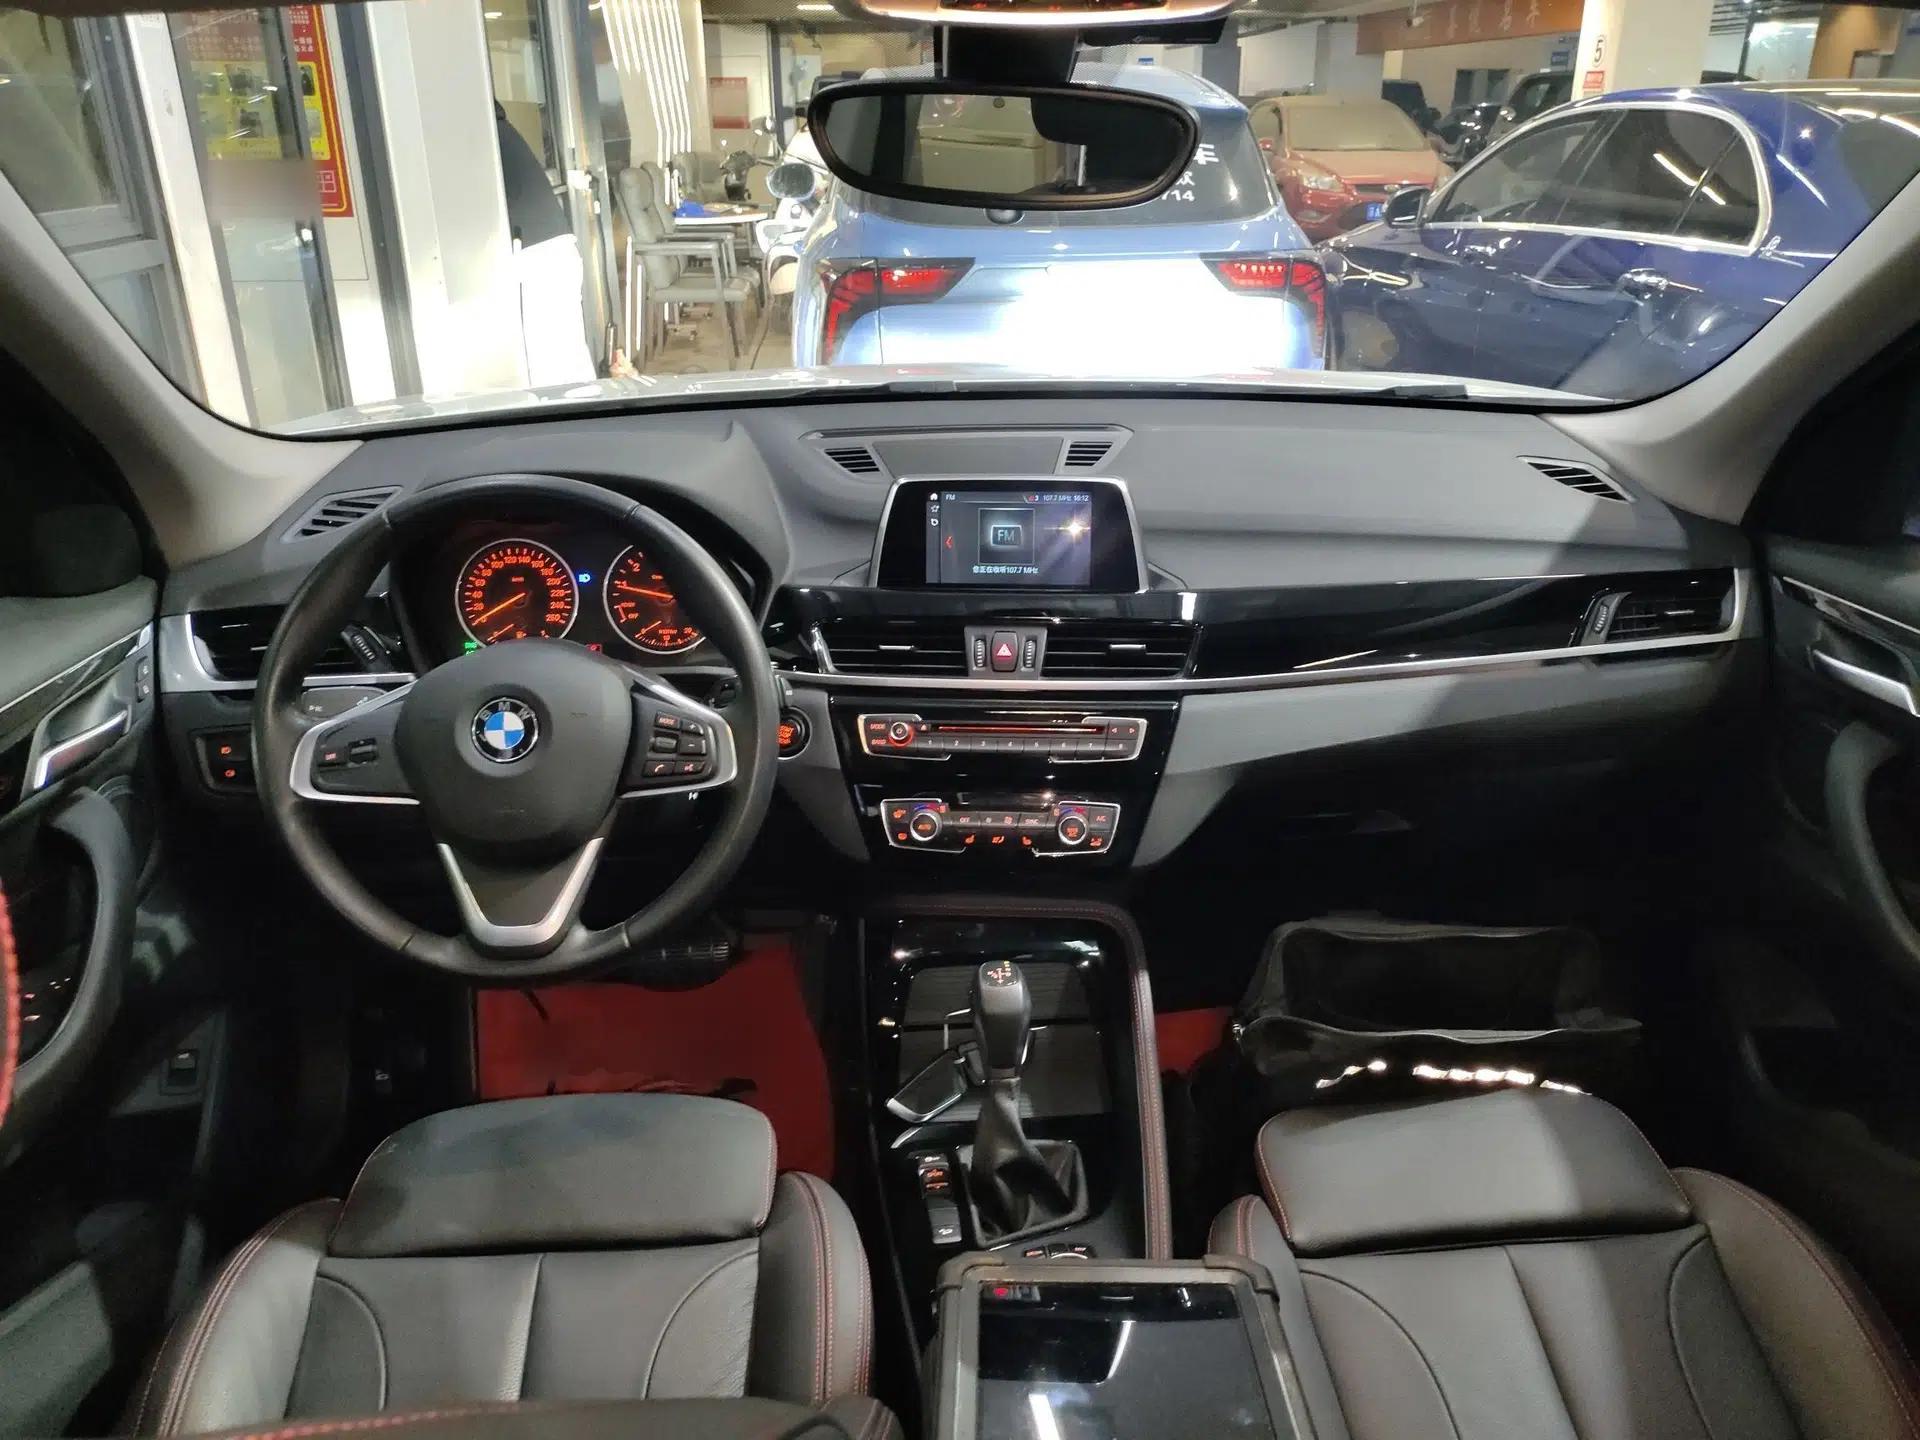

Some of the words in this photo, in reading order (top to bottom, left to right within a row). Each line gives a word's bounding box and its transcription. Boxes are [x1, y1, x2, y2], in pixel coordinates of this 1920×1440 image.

[1594, 39, 1603, 63] 5
[997, 530, 1015, 541] FM
[491, 560, 504, 568] 100
[504, 556, 517, 564] 120
[518, 556, 531, 564] 140
[531, 560, 545, 568] 160
[633, 562, 641, 572] 2
[541, 567, 554, 576] 180
[472, 591, 483, 599] 40
[550, 589, 565, 597] 220
[473, 602, 485, 610] 20
[550, 601, 565, 609] 240
[479, 701, 532, 721] BMW
[959, 816, 971, 824] OFF
